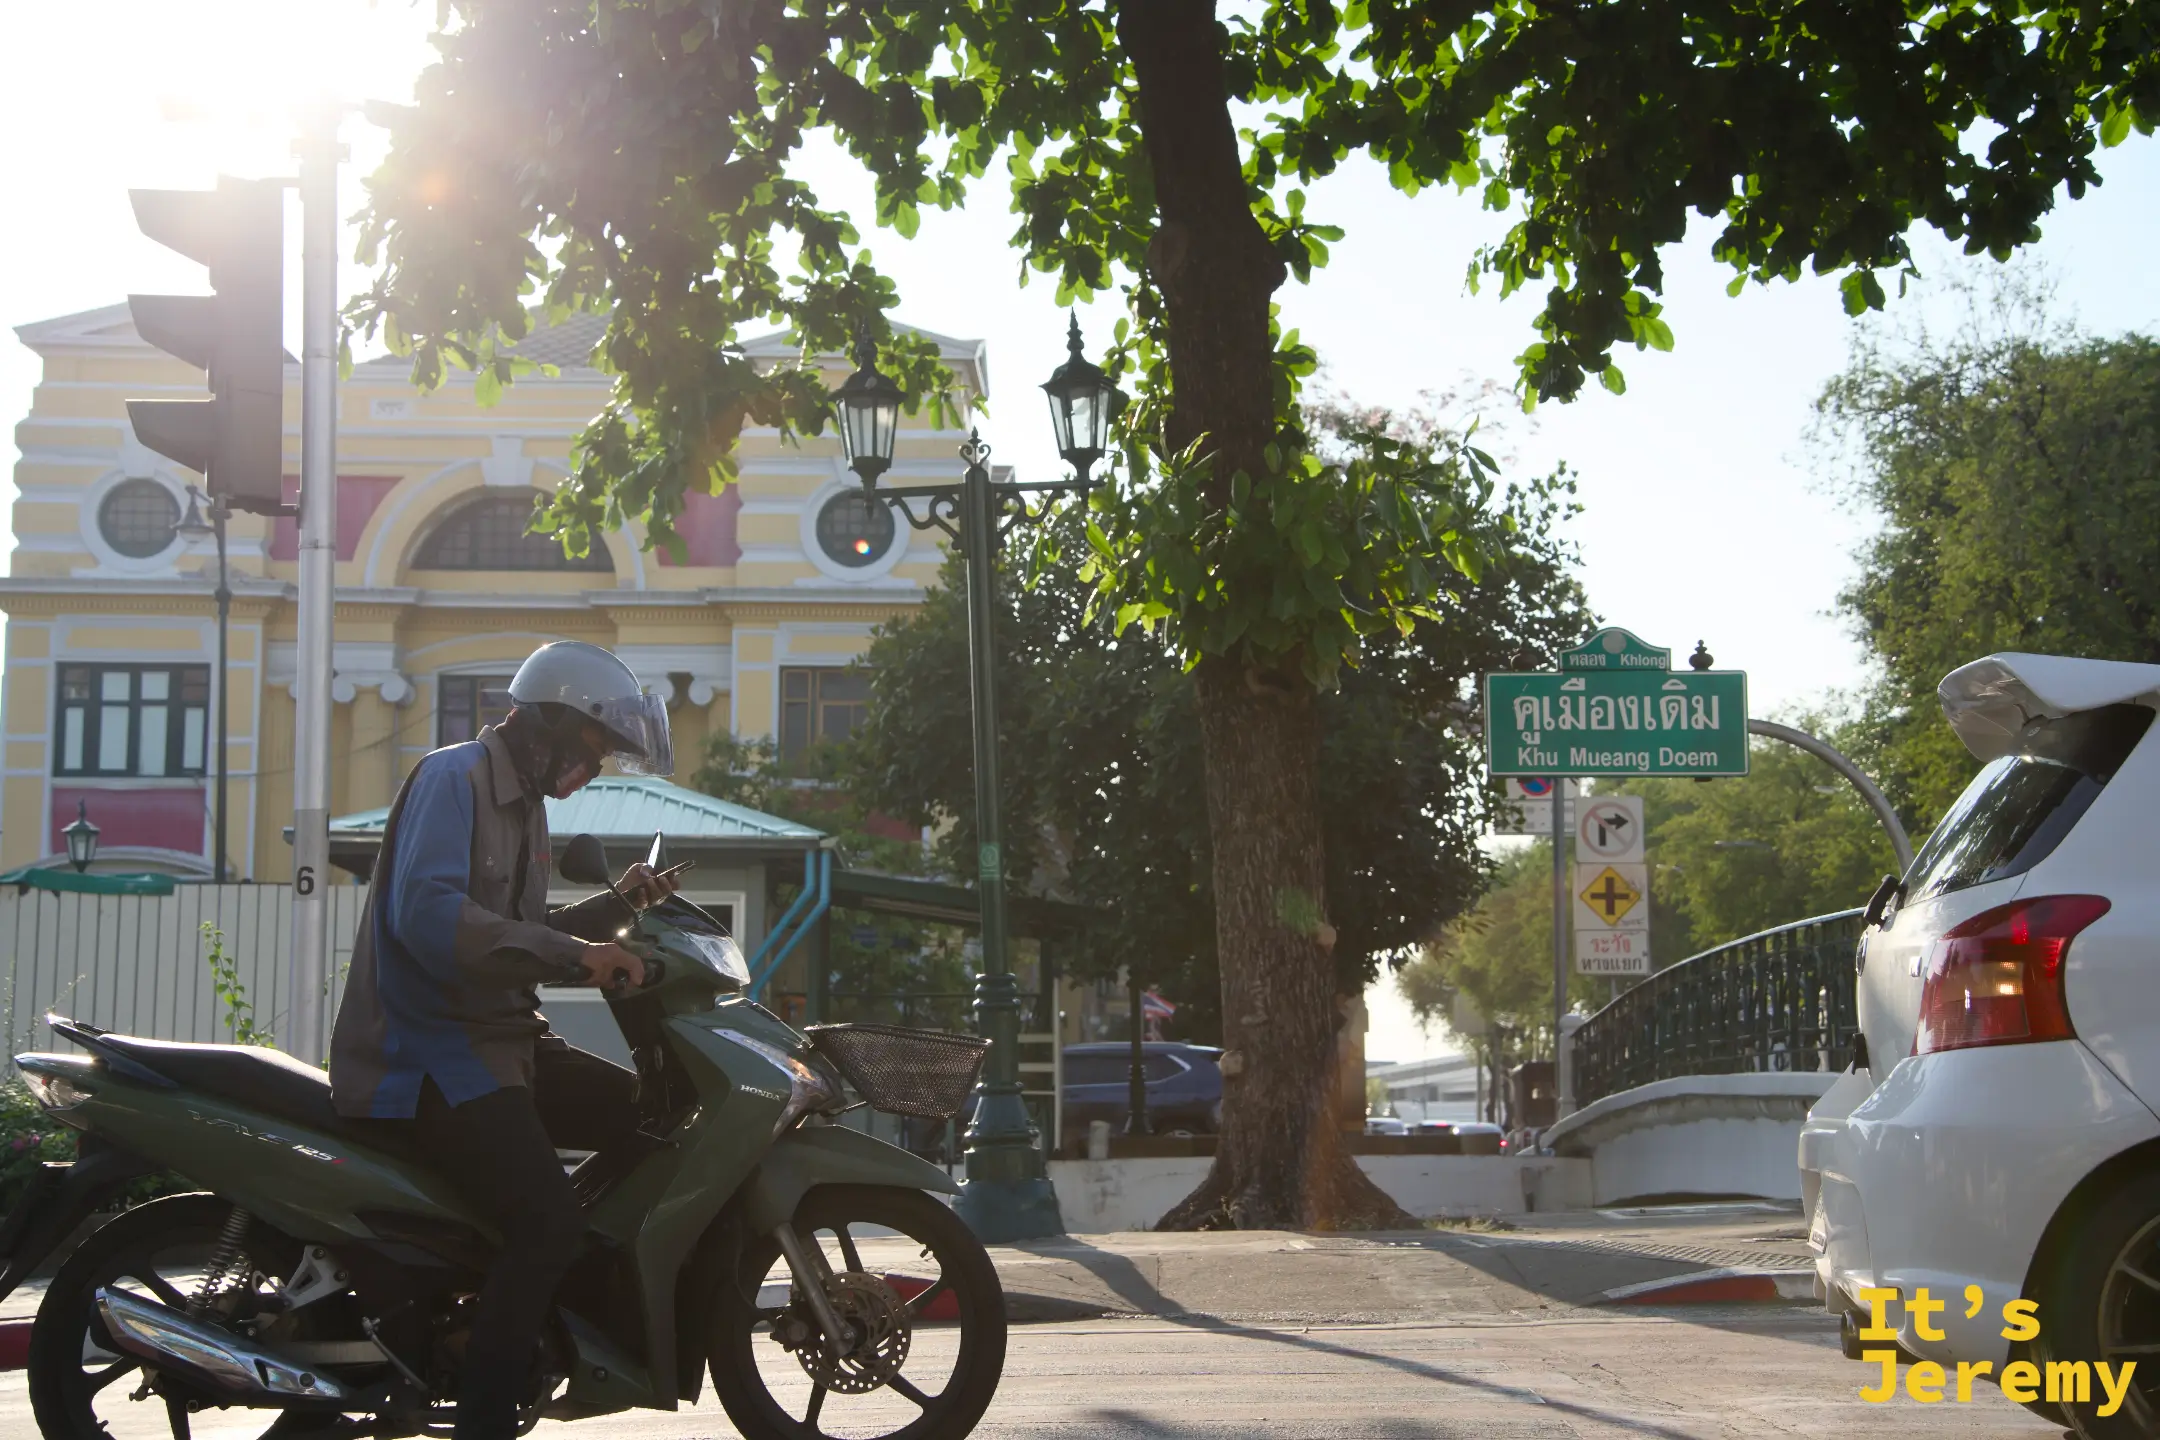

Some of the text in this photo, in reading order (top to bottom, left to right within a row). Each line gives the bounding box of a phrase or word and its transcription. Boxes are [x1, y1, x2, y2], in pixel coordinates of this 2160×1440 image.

[1569, 653, 1606, 667] คลอง
[1620, 653, 1666, 669] Khlong
[1513, 678, 1720, 745] คูเมืองเดิม
[1517, 747, 1718, 771] Khu Mueang Doem
[296, 866, 315, 896] 6
[1581, 957, 1642, 971] ทางแยก
[740, 1084, 780, 1101] HONDA
